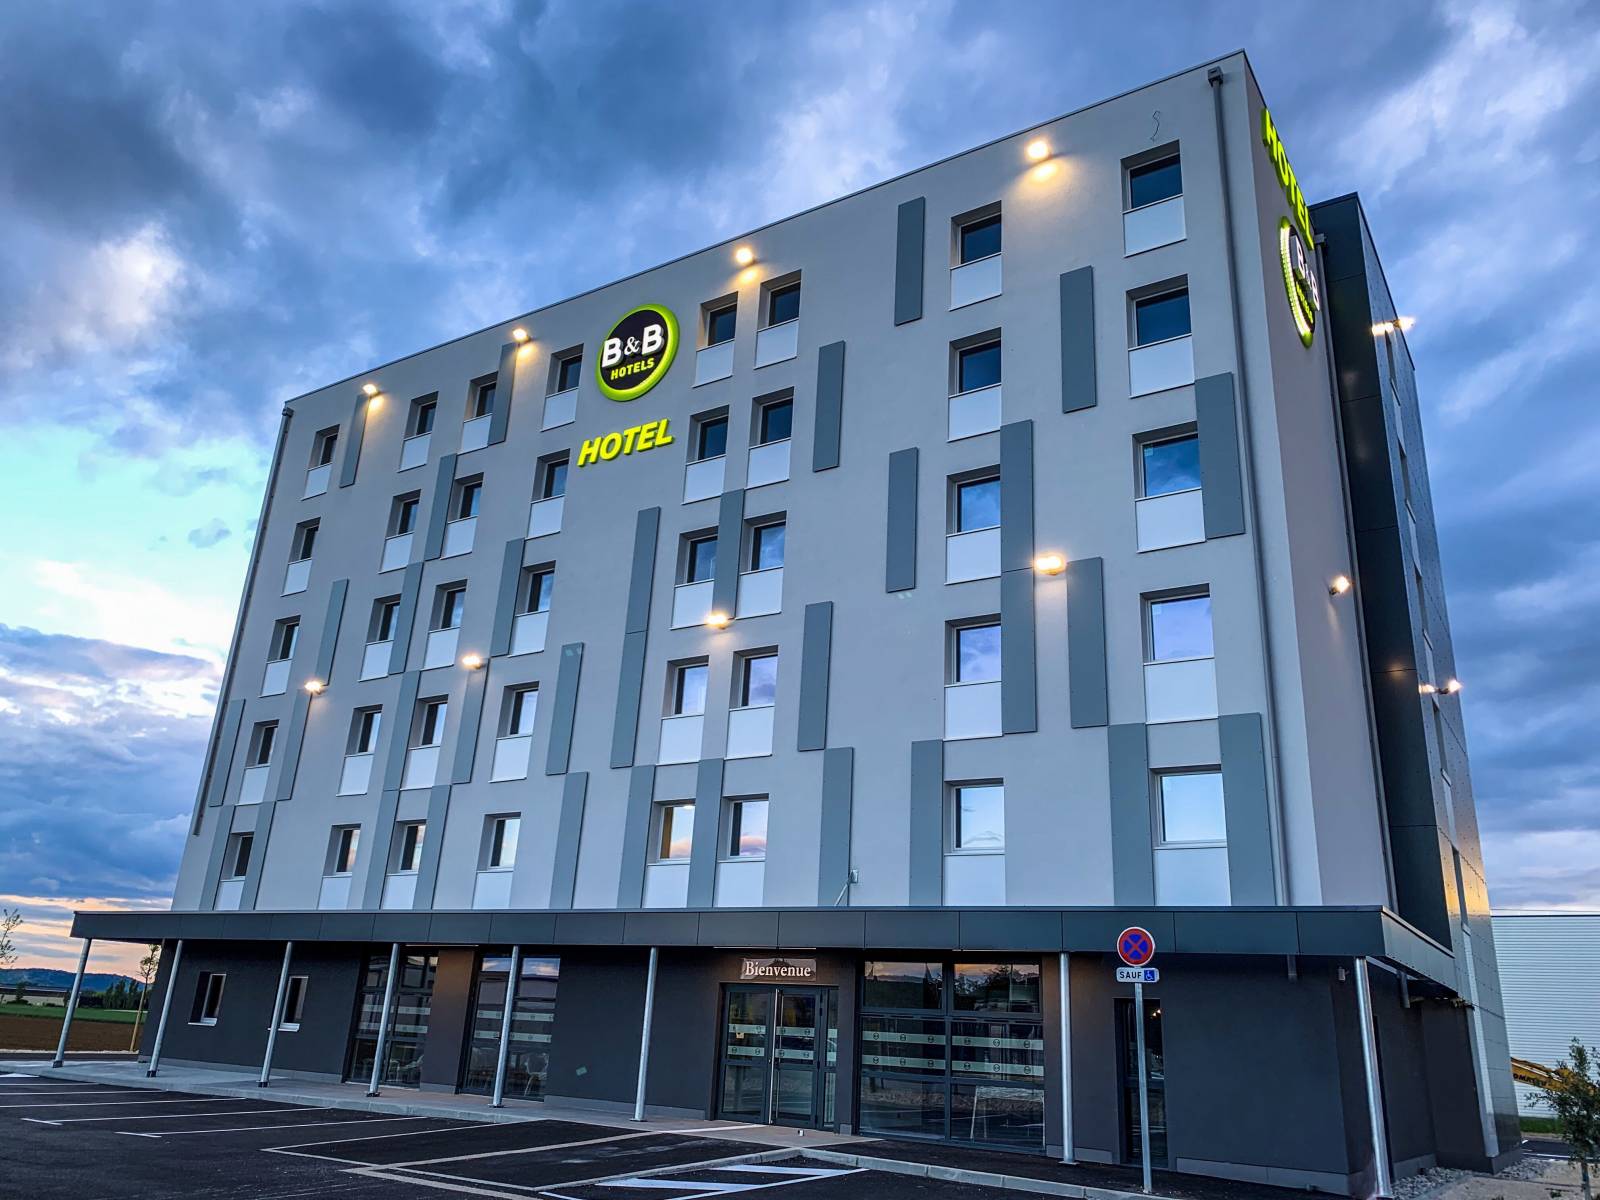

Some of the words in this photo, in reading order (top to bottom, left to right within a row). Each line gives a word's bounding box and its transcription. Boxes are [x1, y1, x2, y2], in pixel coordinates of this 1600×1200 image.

[1262, 108, 1315, 251] HOTEL
[601, 324, 664, 368] B&B
[610, 357, 655, 380] HOTELS
[577, 419, 673, 467] HOTEL
[745, 961, 811, 977] Bienvenue
[1119, 971, 1142, 979] SAUF
